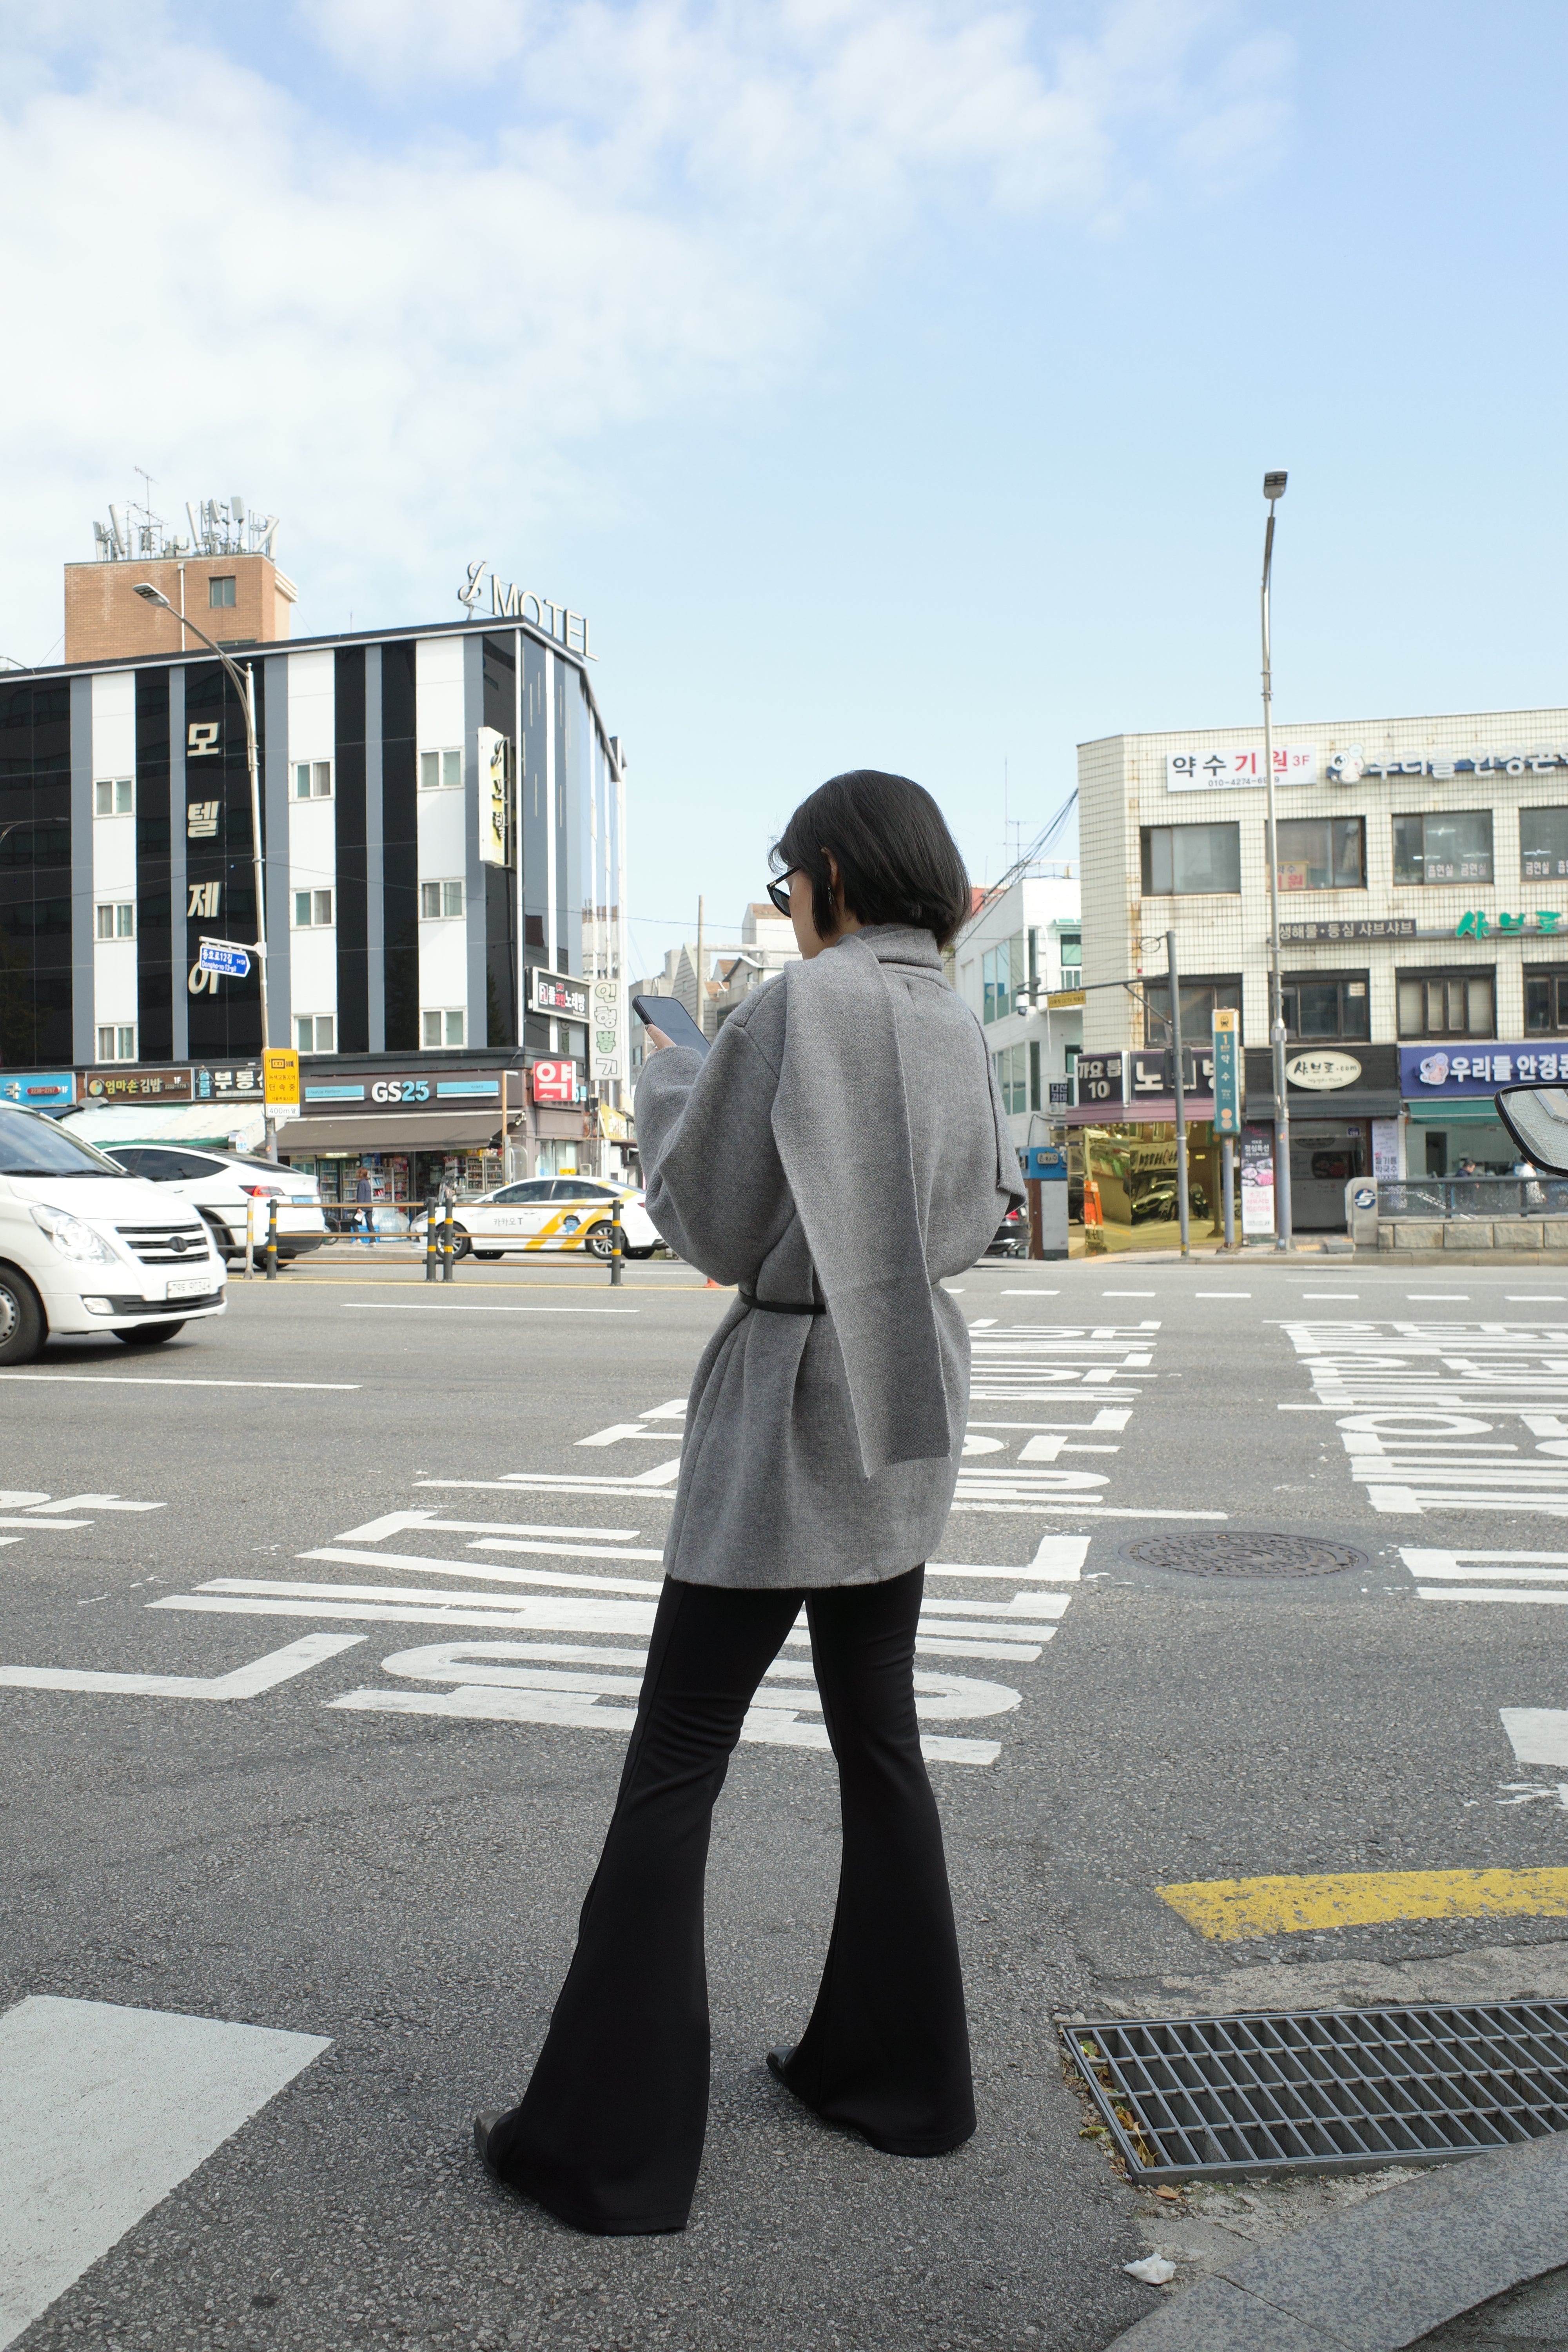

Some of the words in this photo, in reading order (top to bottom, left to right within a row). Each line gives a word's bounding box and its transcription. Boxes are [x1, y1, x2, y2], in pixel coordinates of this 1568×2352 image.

[492, 574, 599, 661] MOTEL
[1293, 755, 1310, 766] 3F
[1369, 746, 1455, 780] 우리들
[1359, 919, 1413, 936] 샤브샤브
[1455, 911, 1562, 940] 샤브로
[202, 949, 233, 964] 동호로12길
[595, 982, 618, 1075] 인형뽑기
[1223, 1034, 1227, 1045] 1
[1450, 1055, 1513, 1082] 우리들
[61, 1085, 68, 1094] 1F
[105, 1079, 138, 1095] 엄마손
[140, 1078, 162, 1093] 김밥
[536, 1063, 572, 1098] 약
[1088, 1080, 1110, 1099] 10
[372, 1080, 430, 1103] GS25
[493, 1217, 516, 1226] 카카오
